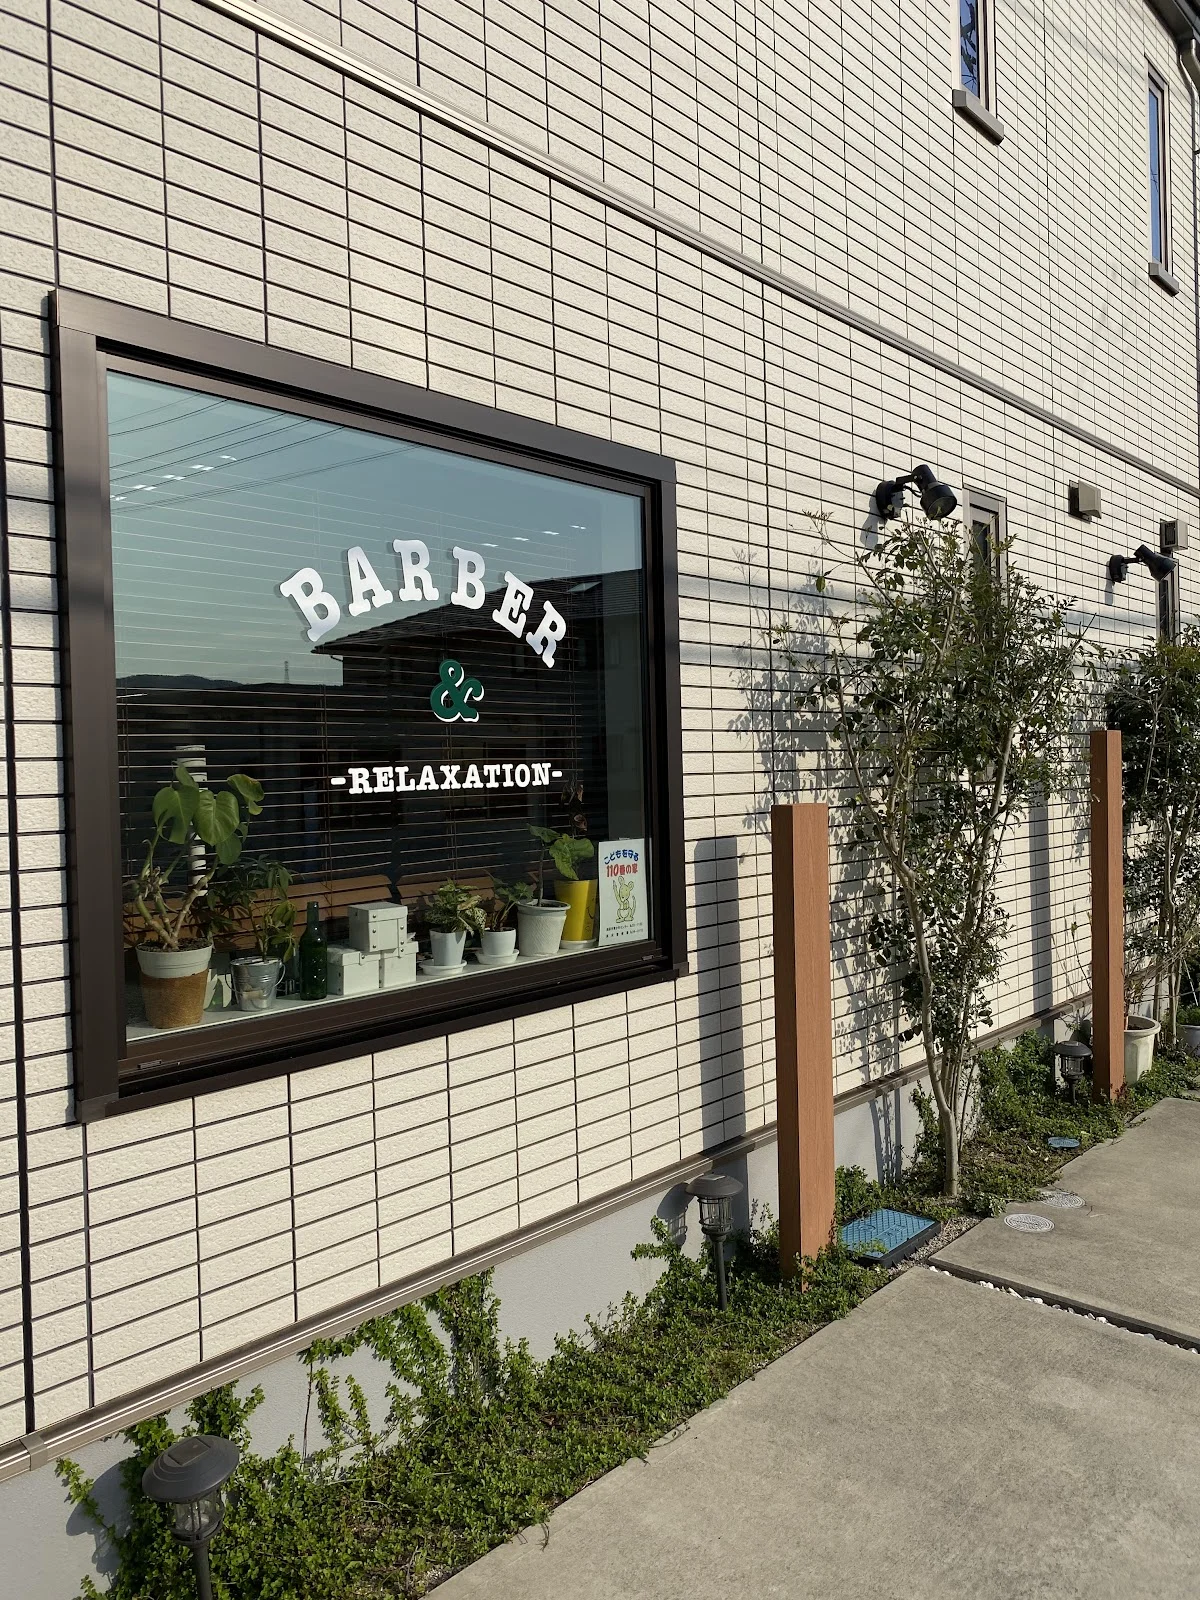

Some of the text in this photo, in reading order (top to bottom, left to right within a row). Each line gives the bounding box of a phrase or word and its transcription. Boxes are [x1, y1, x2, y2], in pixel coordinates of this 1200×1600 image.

[279, 538, 567, 669] BARBER
[430, 659, 484, 723] &
[604, 849, 639, 864] こどもを守る
[606, 864, 638, 877] 110番の家
